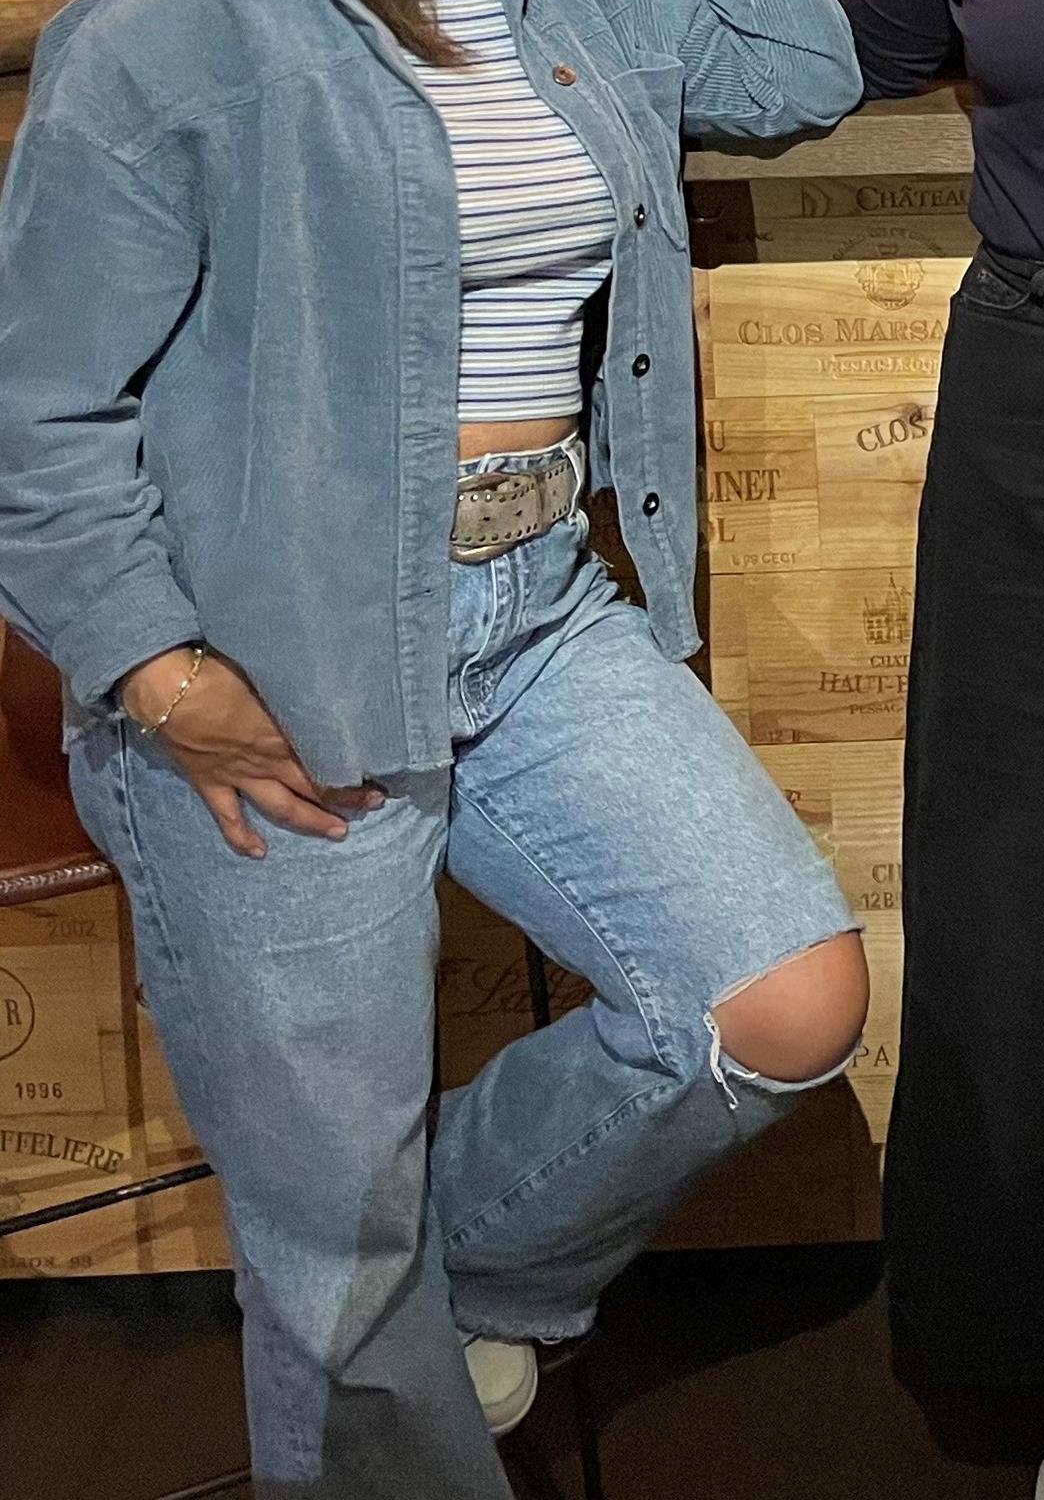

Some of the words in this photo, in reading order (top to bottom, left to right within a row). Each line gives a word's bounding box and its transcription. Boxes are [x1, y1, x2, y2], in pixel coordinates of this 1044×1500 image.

[737, 319, 825, 346] CLOS
[856, 409, 929, 452] CLOS
[708, 469, 781, 503] INET
[5, 998, 23, 1027] R
[15, 1081, 64, 1100] 1996
